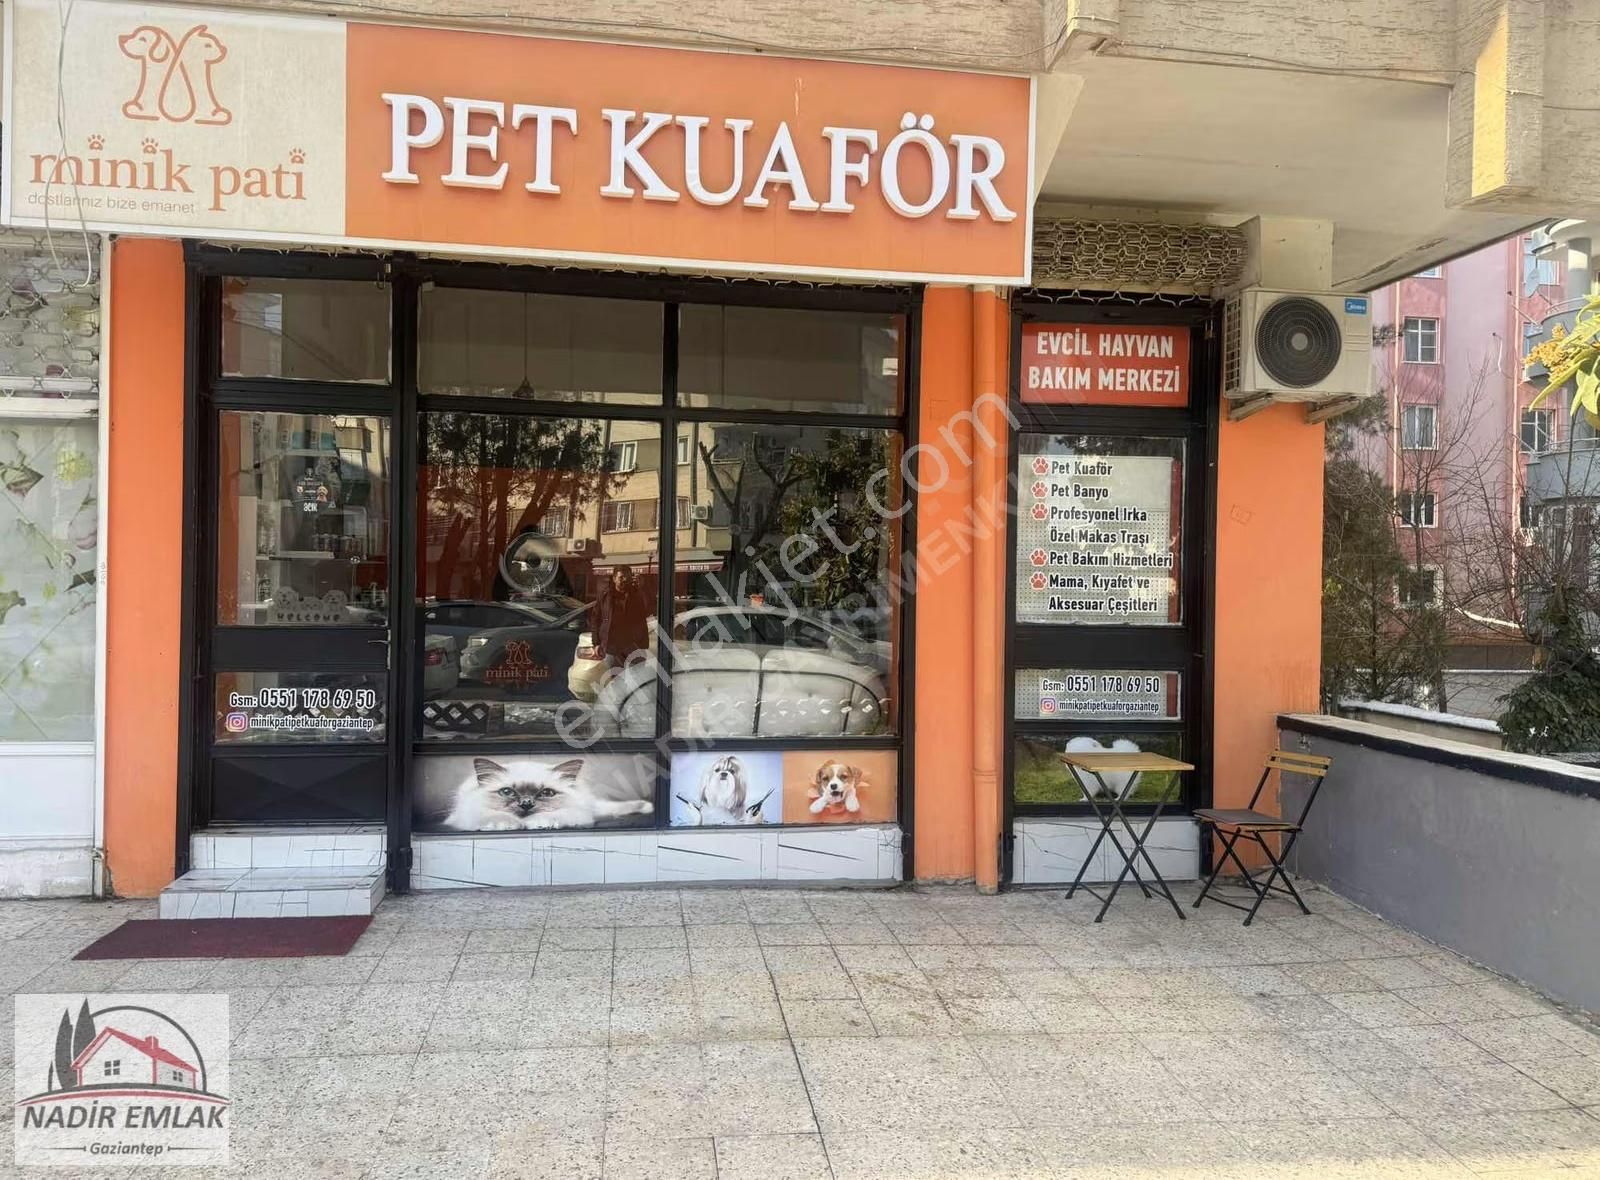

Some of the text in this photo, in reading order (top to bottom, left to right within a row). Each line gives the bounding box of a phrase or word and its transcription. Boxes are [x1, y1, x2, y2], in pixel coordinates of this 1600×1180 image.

[381, 93, 1016, 222] PET KUAFÖR
[29, 134, 307, 212] minik pati
[106, 196, 137, 210] bize
[141, 200, 196, 215] emanet
[1036, 328, 1174, 359] EVCİL HAYVAN
[1028, 364, 1181, 393] BAKIM MERKEZİ
[1051, 461, 1113, 476] Pet Kuaför
[1051, 484, 1109, 501] Pet Banyo
[1050, 506, 1147, 523] Profesyonel Irka
[1050, 525, 1149, 547] Özel Makas Traşı
[1050, 552, 1173, 567] Pet Bakım Hizmetleri
[1049, 575, 1150, 592] Mama, Kıyafet ve
[1049, 597, 1158, 615] Aksesuar Çeşitleri
[1042, 676, 1160, 693] Gsm: 0551 178 69 50
[230, 689, 375, 708] Gsm: 0551 178 69 50
[1059, 700, 1160, 713] minikpatipetkuaforgaziantep
[250, 716, 373, 731] minikpatipetkuaforgaziantep
